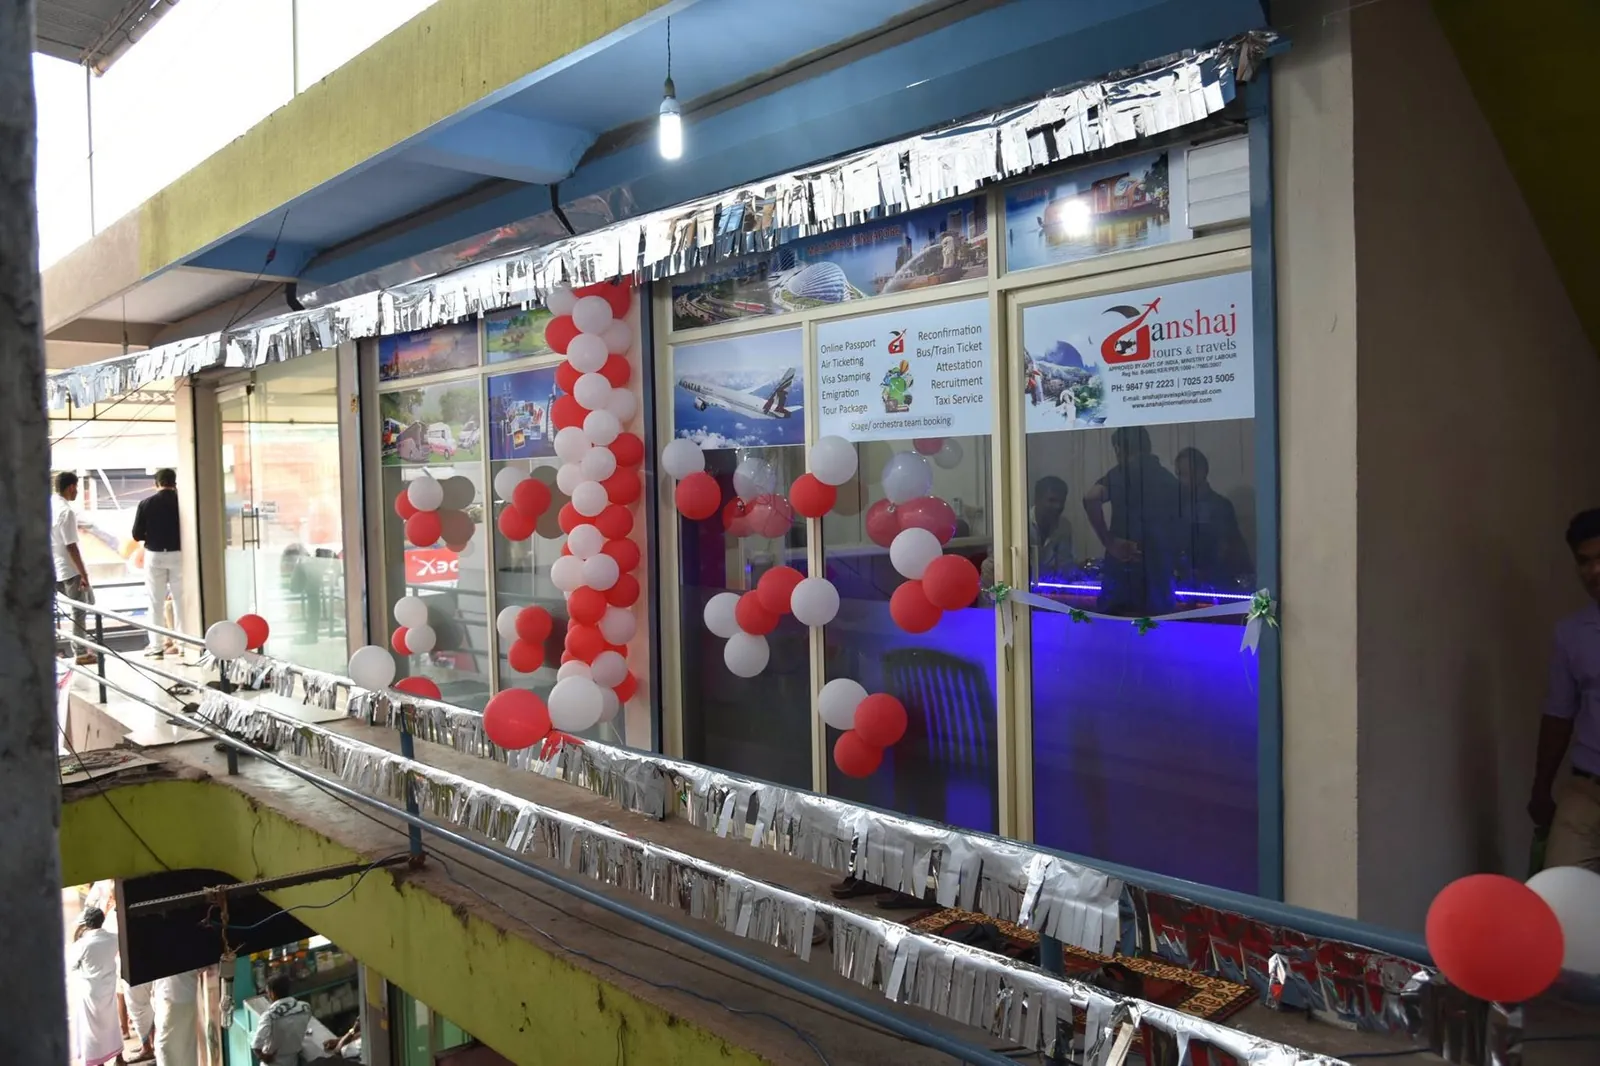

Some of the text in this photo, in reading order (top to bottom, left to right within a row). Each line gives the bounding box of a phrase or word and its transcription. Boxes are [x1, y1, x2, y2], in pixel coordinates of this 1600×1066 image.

[918, 324, 982, 341] Reconfirmation
[820, 338, 876, 354] Online Passport
[916, 341, 982, 358] Bus/Train Ticket
[1152, 347, 1182, 359] tours
[1196, 338, 1237, 354] travels
[821, 357, 864, 369] Air Ticketing
[936, 359, 983, 372] Attestation
[821, 371, 871, 384] Visa Stamping
[931, 376, 983, 389] Recruitment
[1111, 384, 1124, 392] PH:
[1125, 382, 1143, 392] 9847
[1144, 381, 1154, 390] 97
[1155, 379, 1174, 388] 2223
[1183, 376, 1202, 386] 7025
[1203, 375, 1213, 384] 23
[1215, 373, 1235, 383] 5005
[821, 388, 860, 400] Emigration
[934, 393, 984, 406] Taxi Service
[821, 404, 868, 415] Tour Package
[851, 416, 952, 431] Stage/ orchestra team booking
